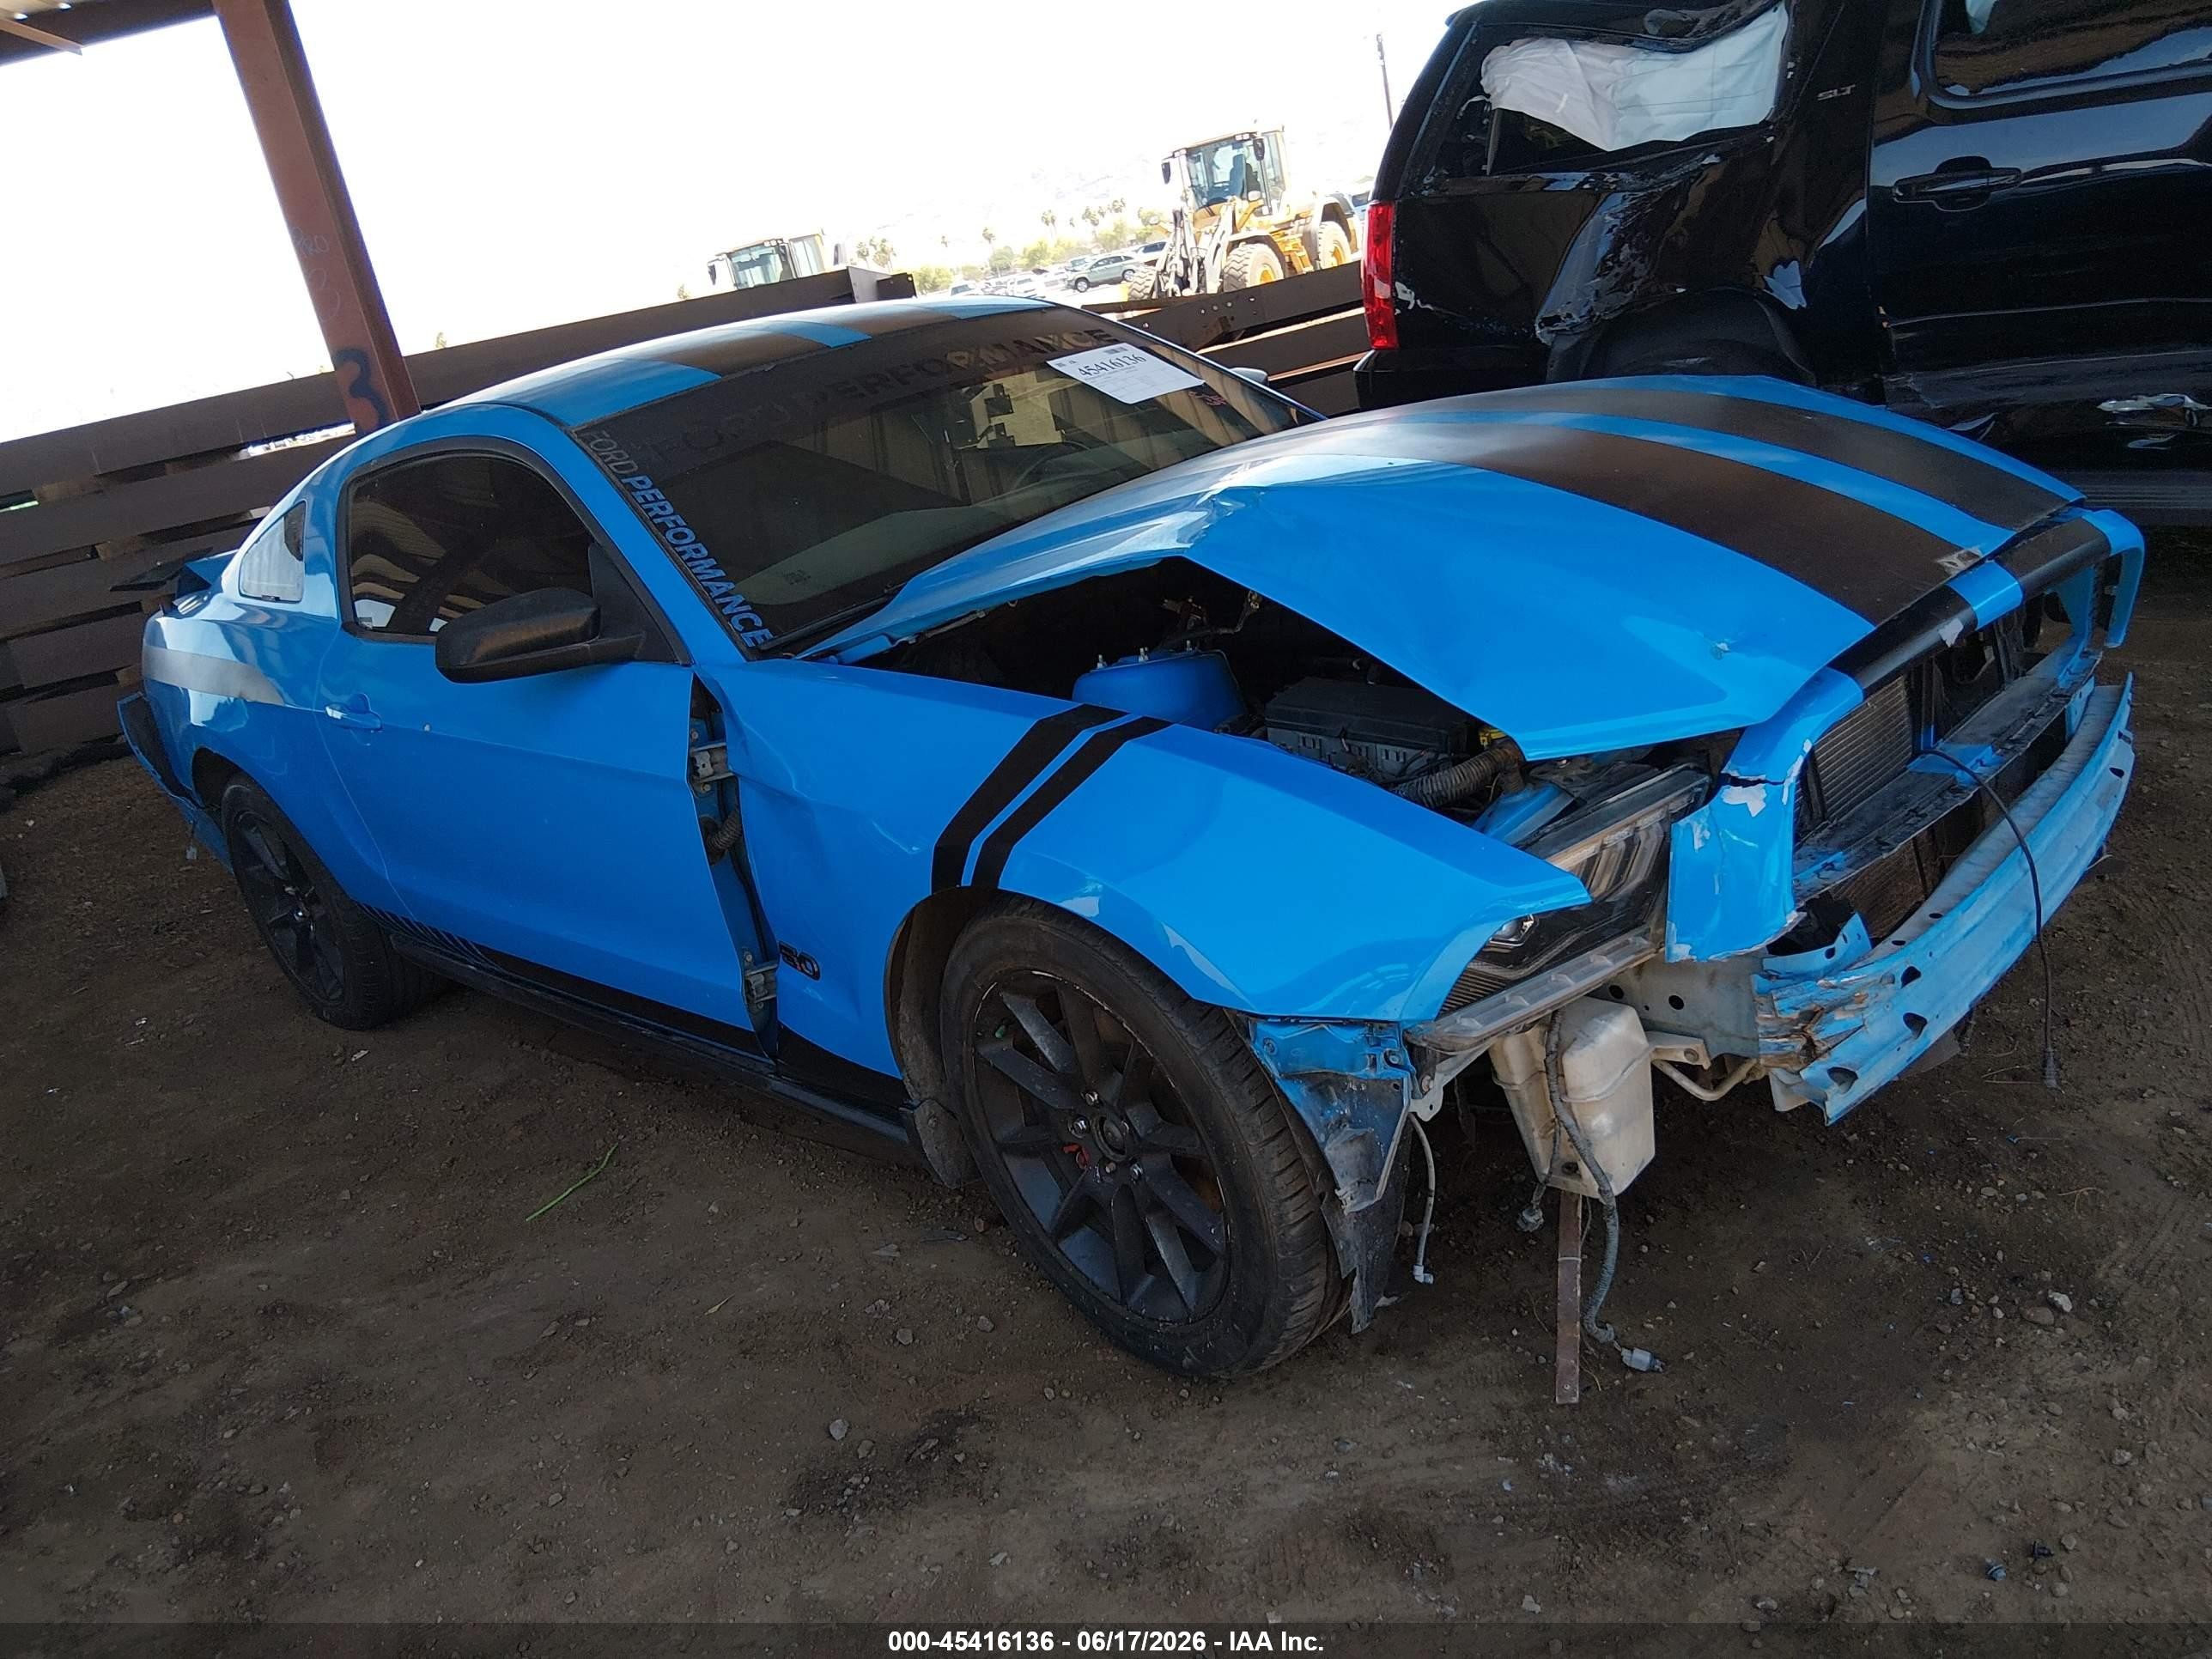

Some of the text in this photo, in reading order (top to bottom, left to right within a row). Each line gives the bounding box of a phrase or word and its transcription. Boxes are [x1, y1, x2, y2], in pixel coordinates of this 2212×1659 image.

[1817, 84, 1856, 101] SLT
[1078, 353, 1147, 377] 45416136
[581, 430, 774, 648] FORD PERFORMANCE
